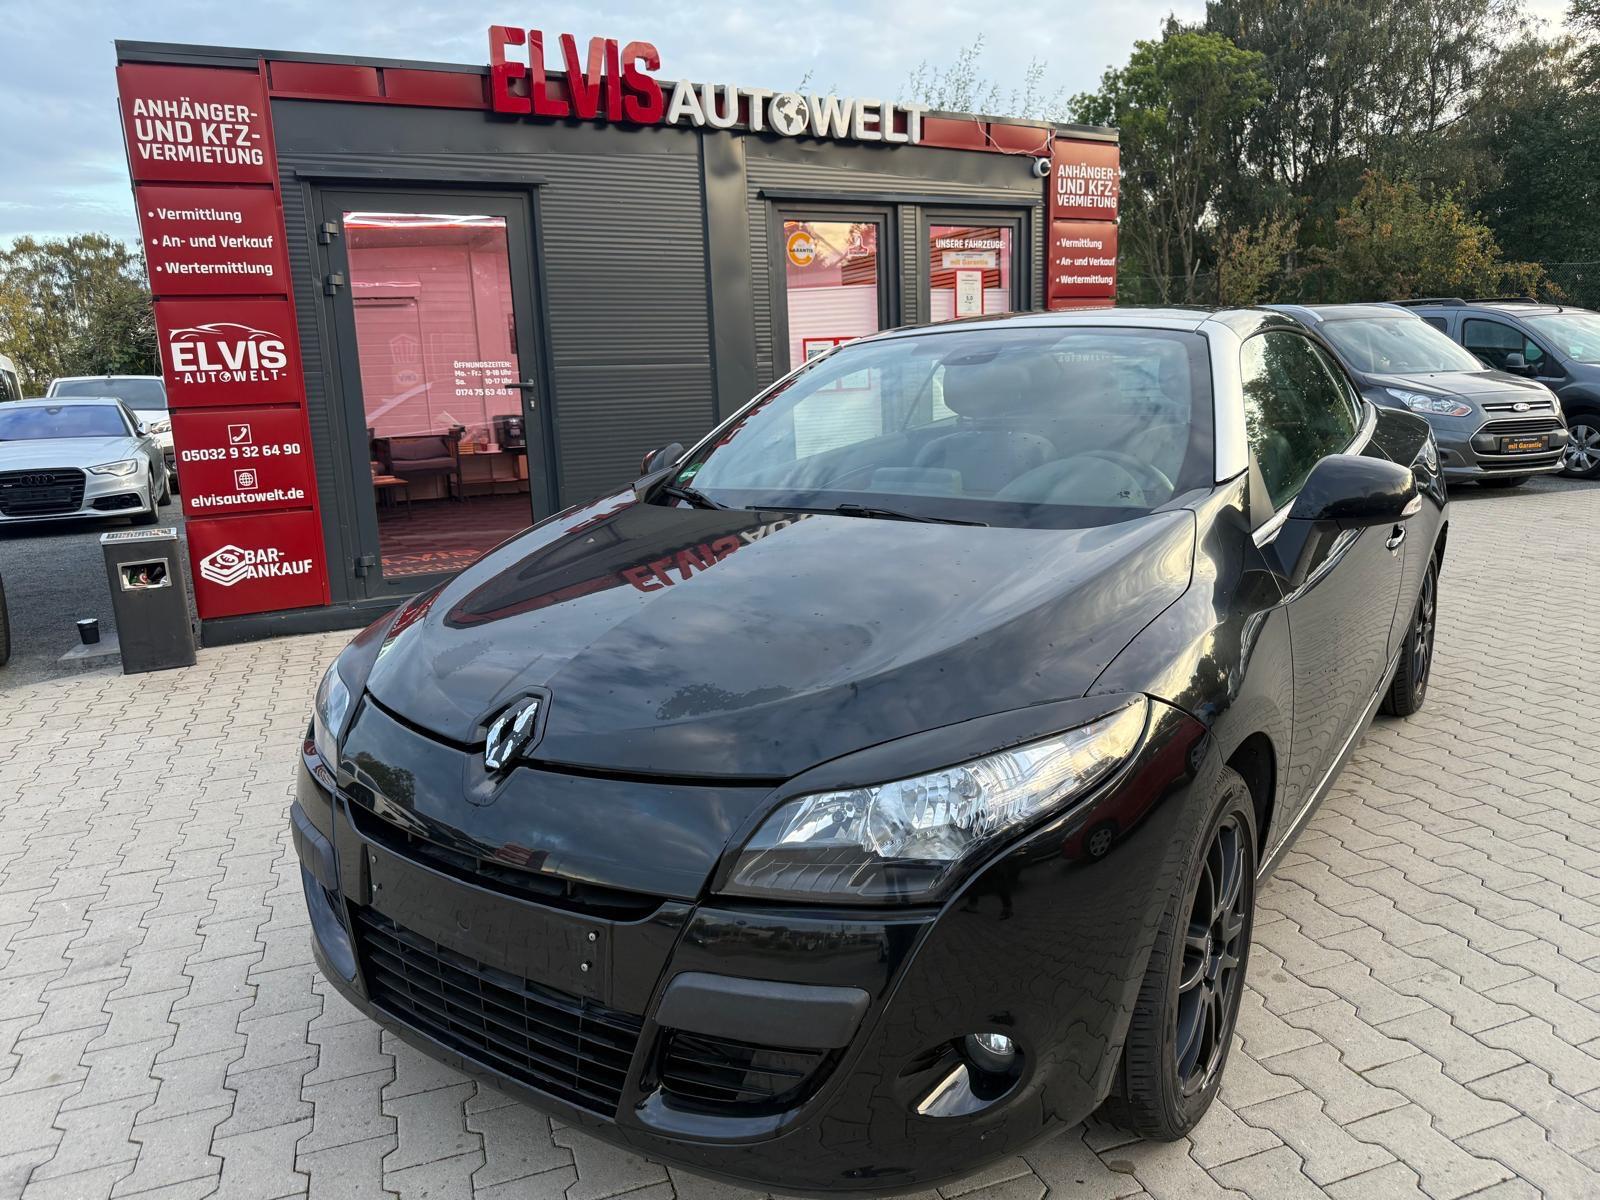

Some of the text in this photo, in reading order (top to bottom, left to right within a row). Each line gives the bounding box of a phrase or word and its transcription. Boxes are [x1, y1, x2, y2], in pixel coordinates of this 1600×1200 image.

[488, 24, 928, 145] ELVIS AUTOWELT
[133, 97, 258, 123] ANHÄNGER-
[135, 119, 260, 147] UND KFZ-
[138, 143, 264, 165] VERMIETUNG
[1057, 162, 1117, 180] ANHÄNGER-
[1057, 178, 1117, 196] UND KFZ-
[1057, 194, 1117, 208] VERMIETUNG
[157, 207, 242, 224] Vermittlung
[162, 235, 273, 248] An- und Verkauf
[935, 238, 964, 249] UNSERE
[1060, 238, 1102, 250] Vermittlung
[165, 261, 273, 276] Wertermittlung
[1060, 256, 1116, 267] An- und Verkauf
[1060, 275, 1113, 286] Wertermittlung
[170, 340, 287, 372] ELVIS
[455, 388, 473, 396] 0174
[474, 388, 484, 396] 75
[496, 388, 507, 396] 40
[181, 443, 301, 462] 05032 9 32 64 90
[191, 487, 304, 508] elvisautowelt.de
[244, 547, 285, 565] BAR-
[246, 559, 313, 579] ANKAUF
